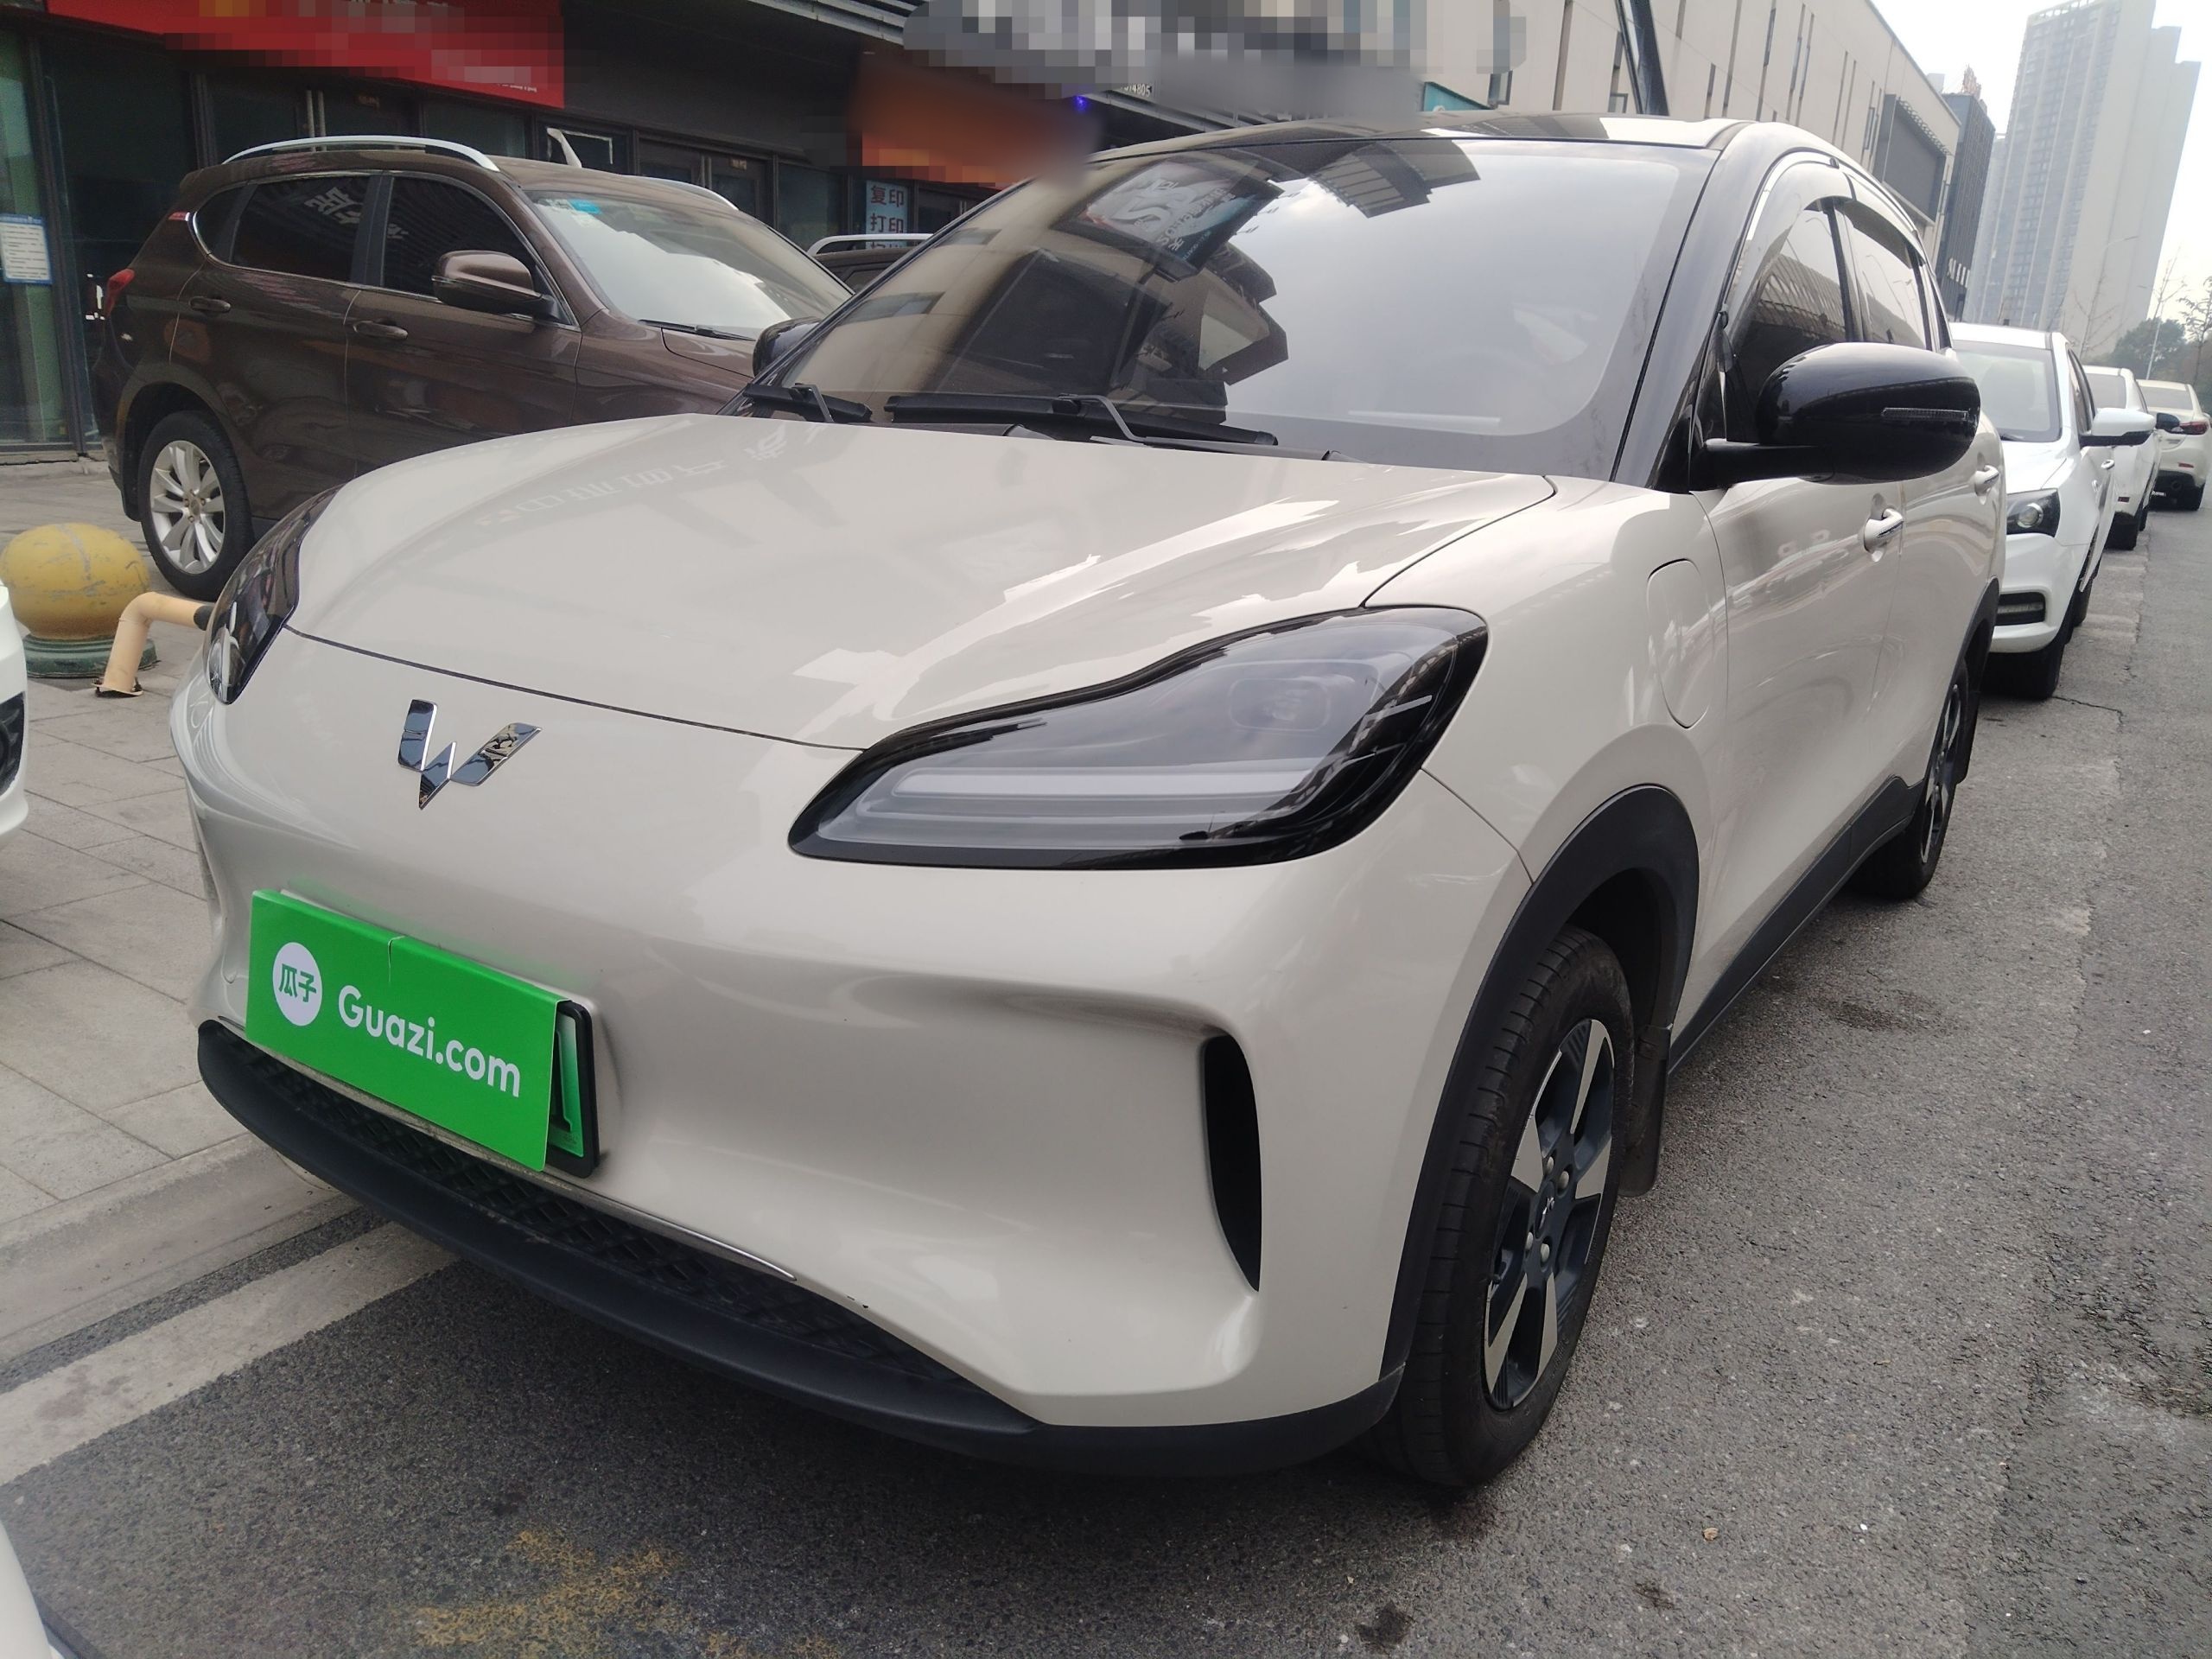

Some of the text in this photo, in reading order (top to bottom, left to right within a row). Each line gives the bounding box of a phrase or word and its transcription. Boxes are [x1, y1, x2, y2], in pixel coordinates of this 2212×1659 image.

[871, 185, 904, 207] 复印
[871, 213, 904, 233] 打印
[278, 963, 317, 1003] 瓜子
[338, 985, 520, 1097] Guazi.com
